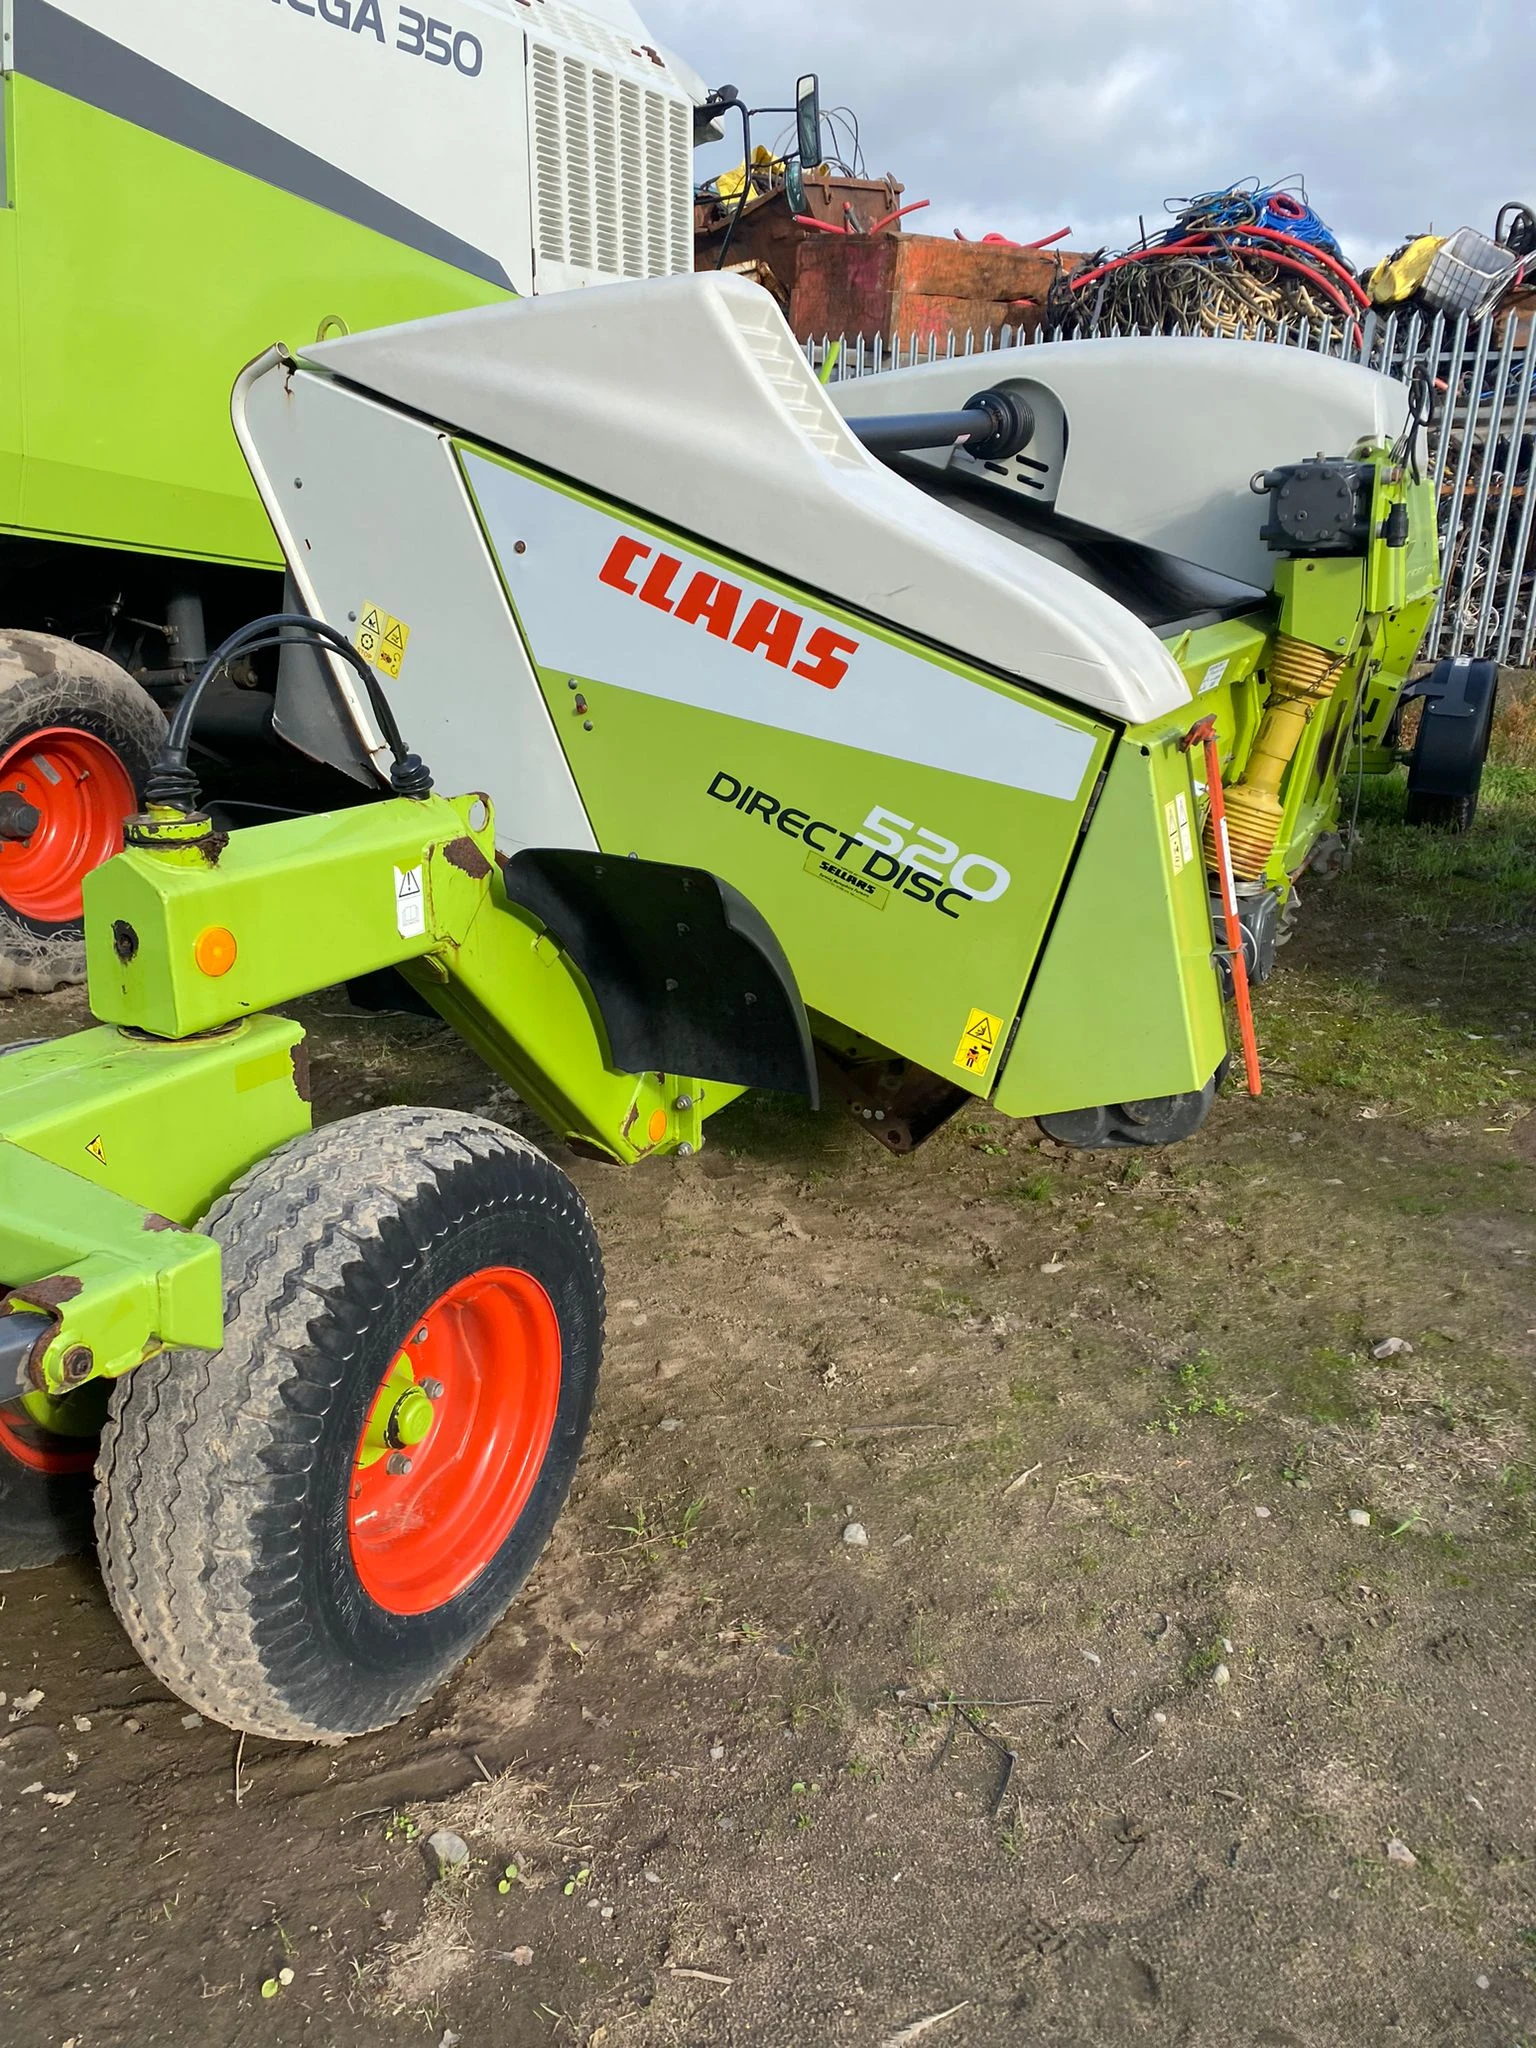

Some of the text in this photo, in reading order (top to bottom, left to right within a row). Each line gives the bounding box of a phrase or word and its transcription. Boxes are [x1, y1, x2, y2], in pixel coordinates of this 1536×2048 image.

[396, 5, 483, 77] 350
[598, 535, 860, 690] CLAAS
[706, 770, 974, 920] DIRECT DISC
[818, 860, 877, 896] SELLARS
[853, 804, 1012, 903] 520
